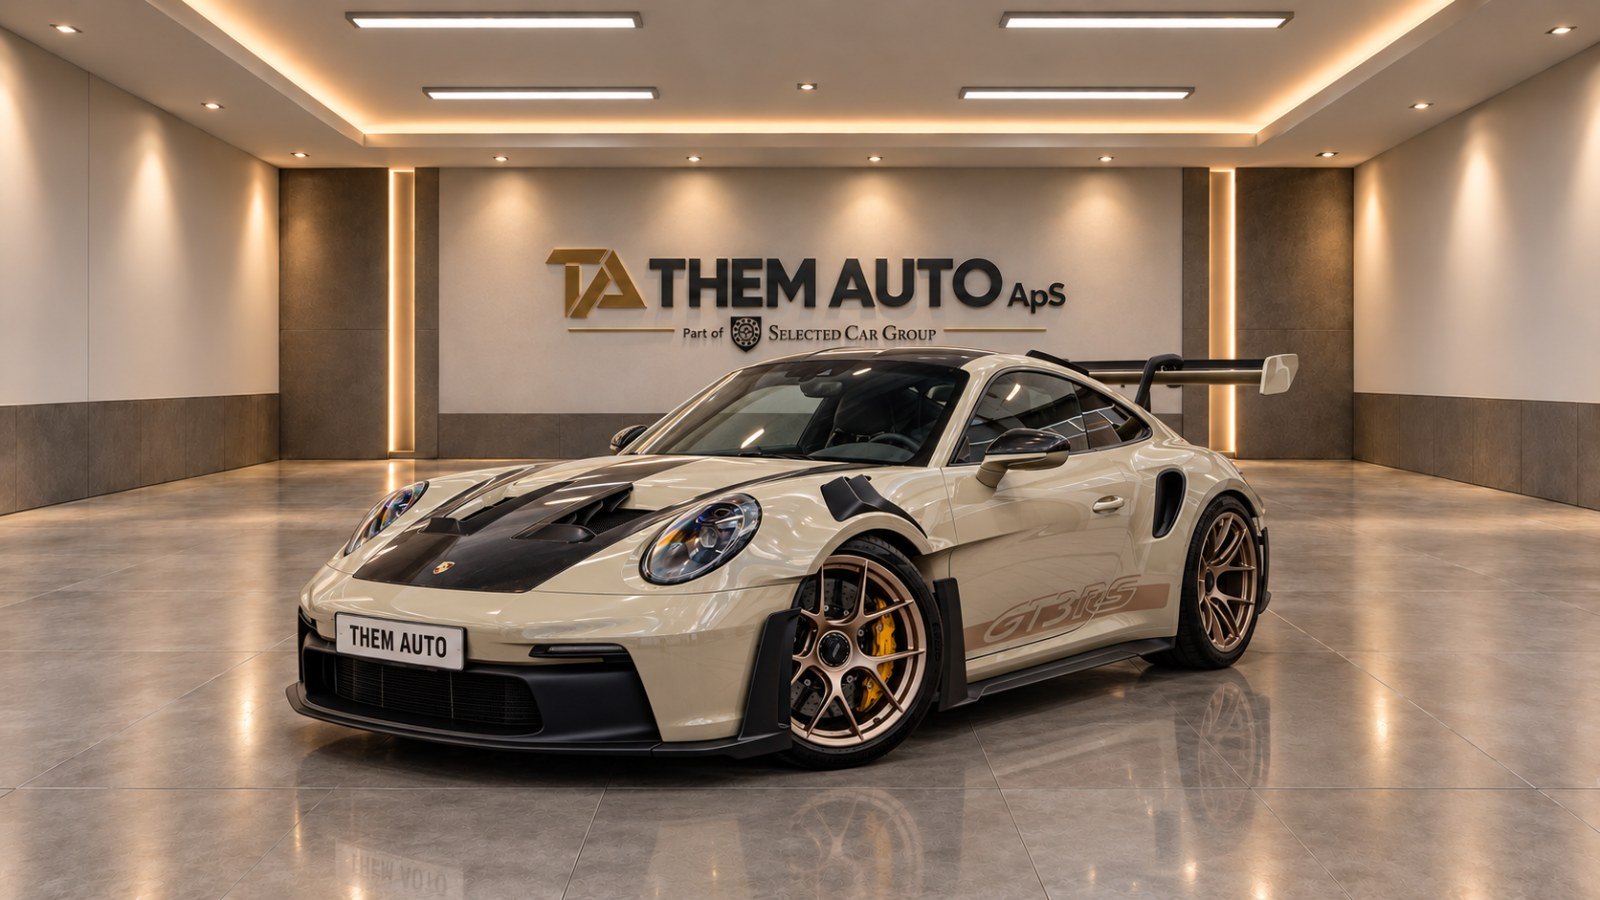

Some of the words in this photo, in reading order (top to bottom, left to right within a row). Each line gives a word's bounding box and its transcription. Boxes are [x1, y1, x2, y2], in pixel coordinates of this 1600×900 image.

[649, 258, 816, 308] THEM
[829, 258, 1003, 308] AUTO
[1007, 282, 1066, 314] ApS
[683, 327, 708, 339] Part
[710, 326, 724, 339] of
[350, 625, 394, 652] THEM
[400, 631, 447, 658] AUTO
